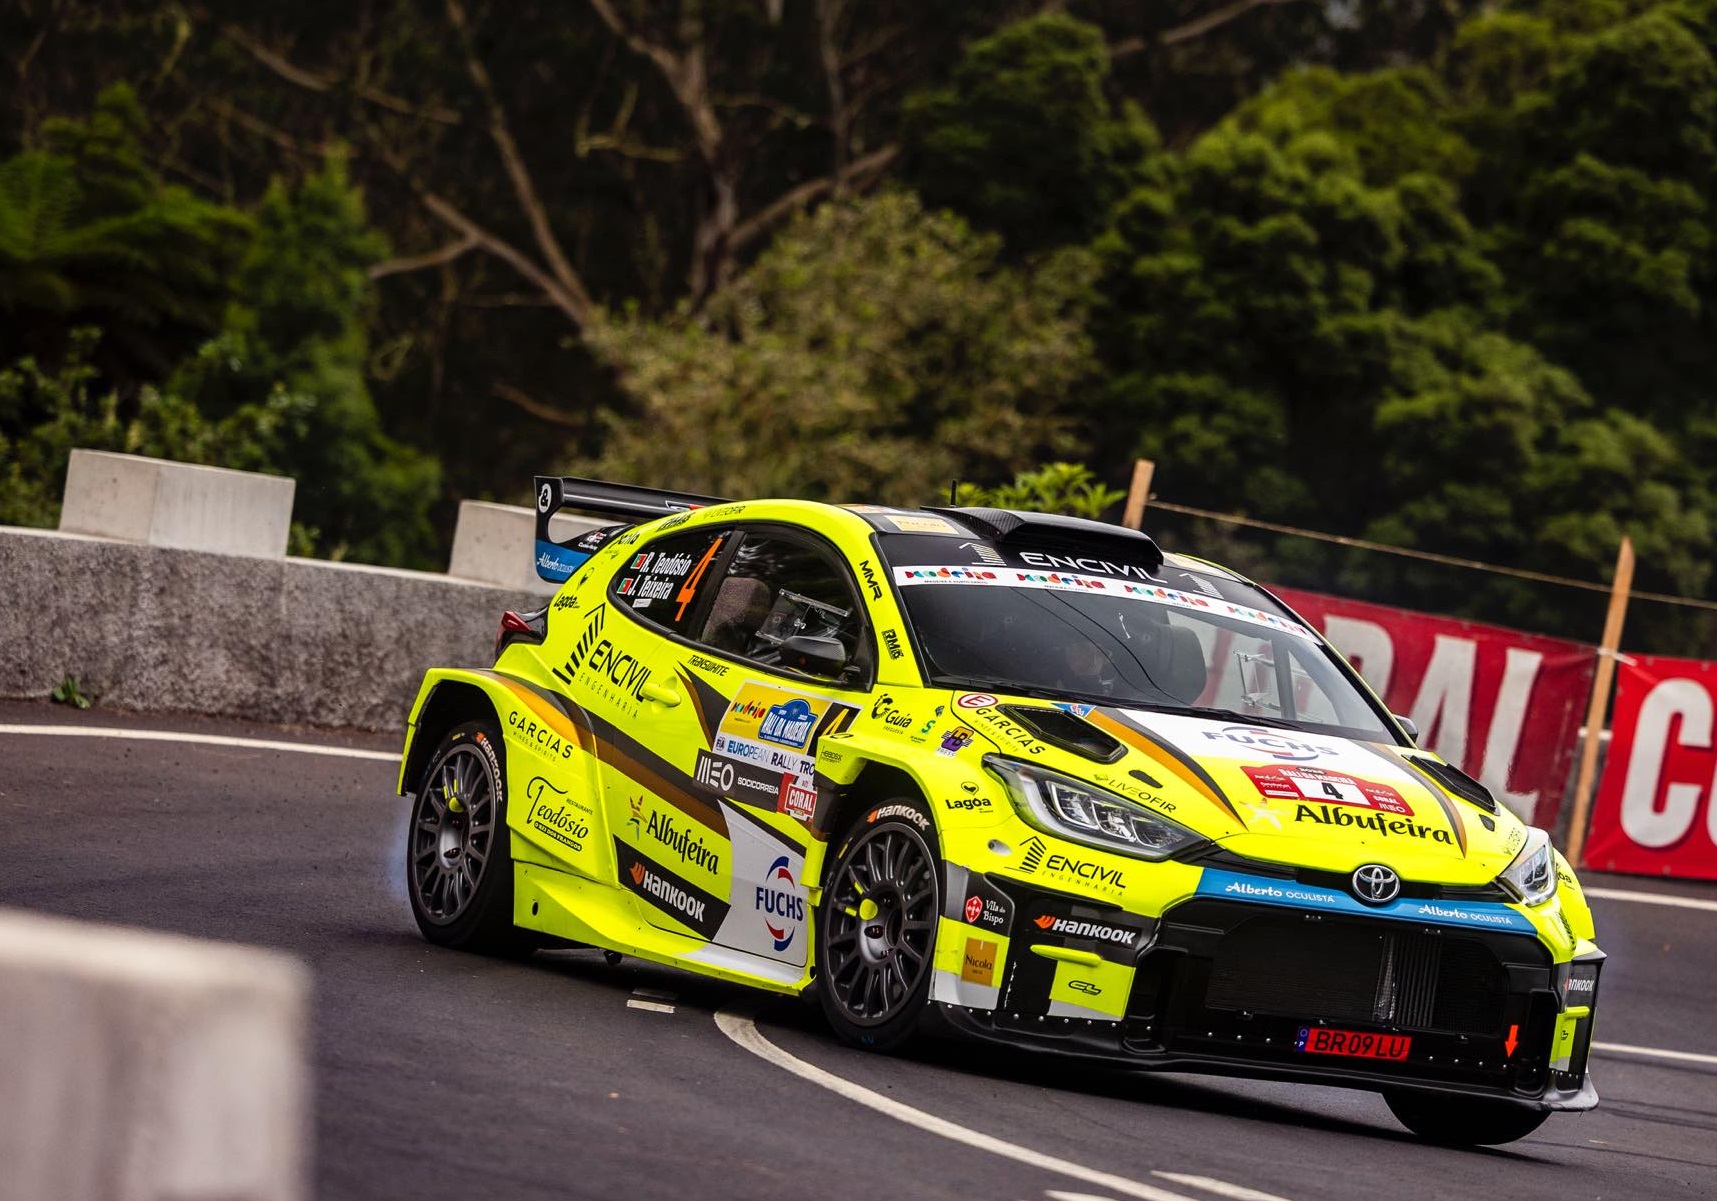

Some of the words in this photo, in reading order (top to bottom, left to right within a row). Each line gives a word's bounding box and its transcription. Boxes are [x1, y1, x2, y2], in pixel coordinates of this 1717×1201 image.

[650, 551, 692, 577] Teodósio
[1019, 551, 1169, 584] ENCIVIL
[639, 574, 674, 600] Teixeira
[674, 538, 724, 623] 4
[860, 560, 882, 602] MMR
[588, 639, 653, 704] ENCIVIL
[687, 654, 730, 677] TRANSWHITE
[579, 672, 639, 720] ENGENHARIA
[509, 710, 574, 759] GARCIAS
[976, 707, 1046, 755] GARCIAS
[1201, 731, 1340, 756] FUCHS
[727, 739, 770, 764] EUROPEAN
[771, 752, 799, 771] RALLY
[738, 776, 779, 796] SOCICORREIA
[1108, 779, 1177, 814] LIVEOFIR
[1321, 782, 1345, 800] 4
[527, 775, 595, 840] Teodósio
[789, 789, 813, 812] CORAL
[945, 798, 992, 811] Lagoa
[1294, 803, 1454, 845] Albufeira
[646, 809, 719, 875] Albufeira
[1042, 870, 1123, 896] ENGENHARIA
[1046, 854, 1127, 889] ENCIVIL
[755, 886, 804, 922] FUCHS
[985, 899, 999, 912] Vila
[1225, 884, 1283, 897] Alberto
[1285, 890, 1335, 903] OCULISTA
[983, 911, 1004, 926] Bispo
[1418, 904, 1468, 919] Alberto
[1470, 913, 1513, 925] OCULISTA
[965, 954, 993, 970] Nicola
[1314, 1030, 1347, 1053] BR
[1348, 1033, 1374, 1056] 09
[1375, 1037, 1406, 1058] LU
